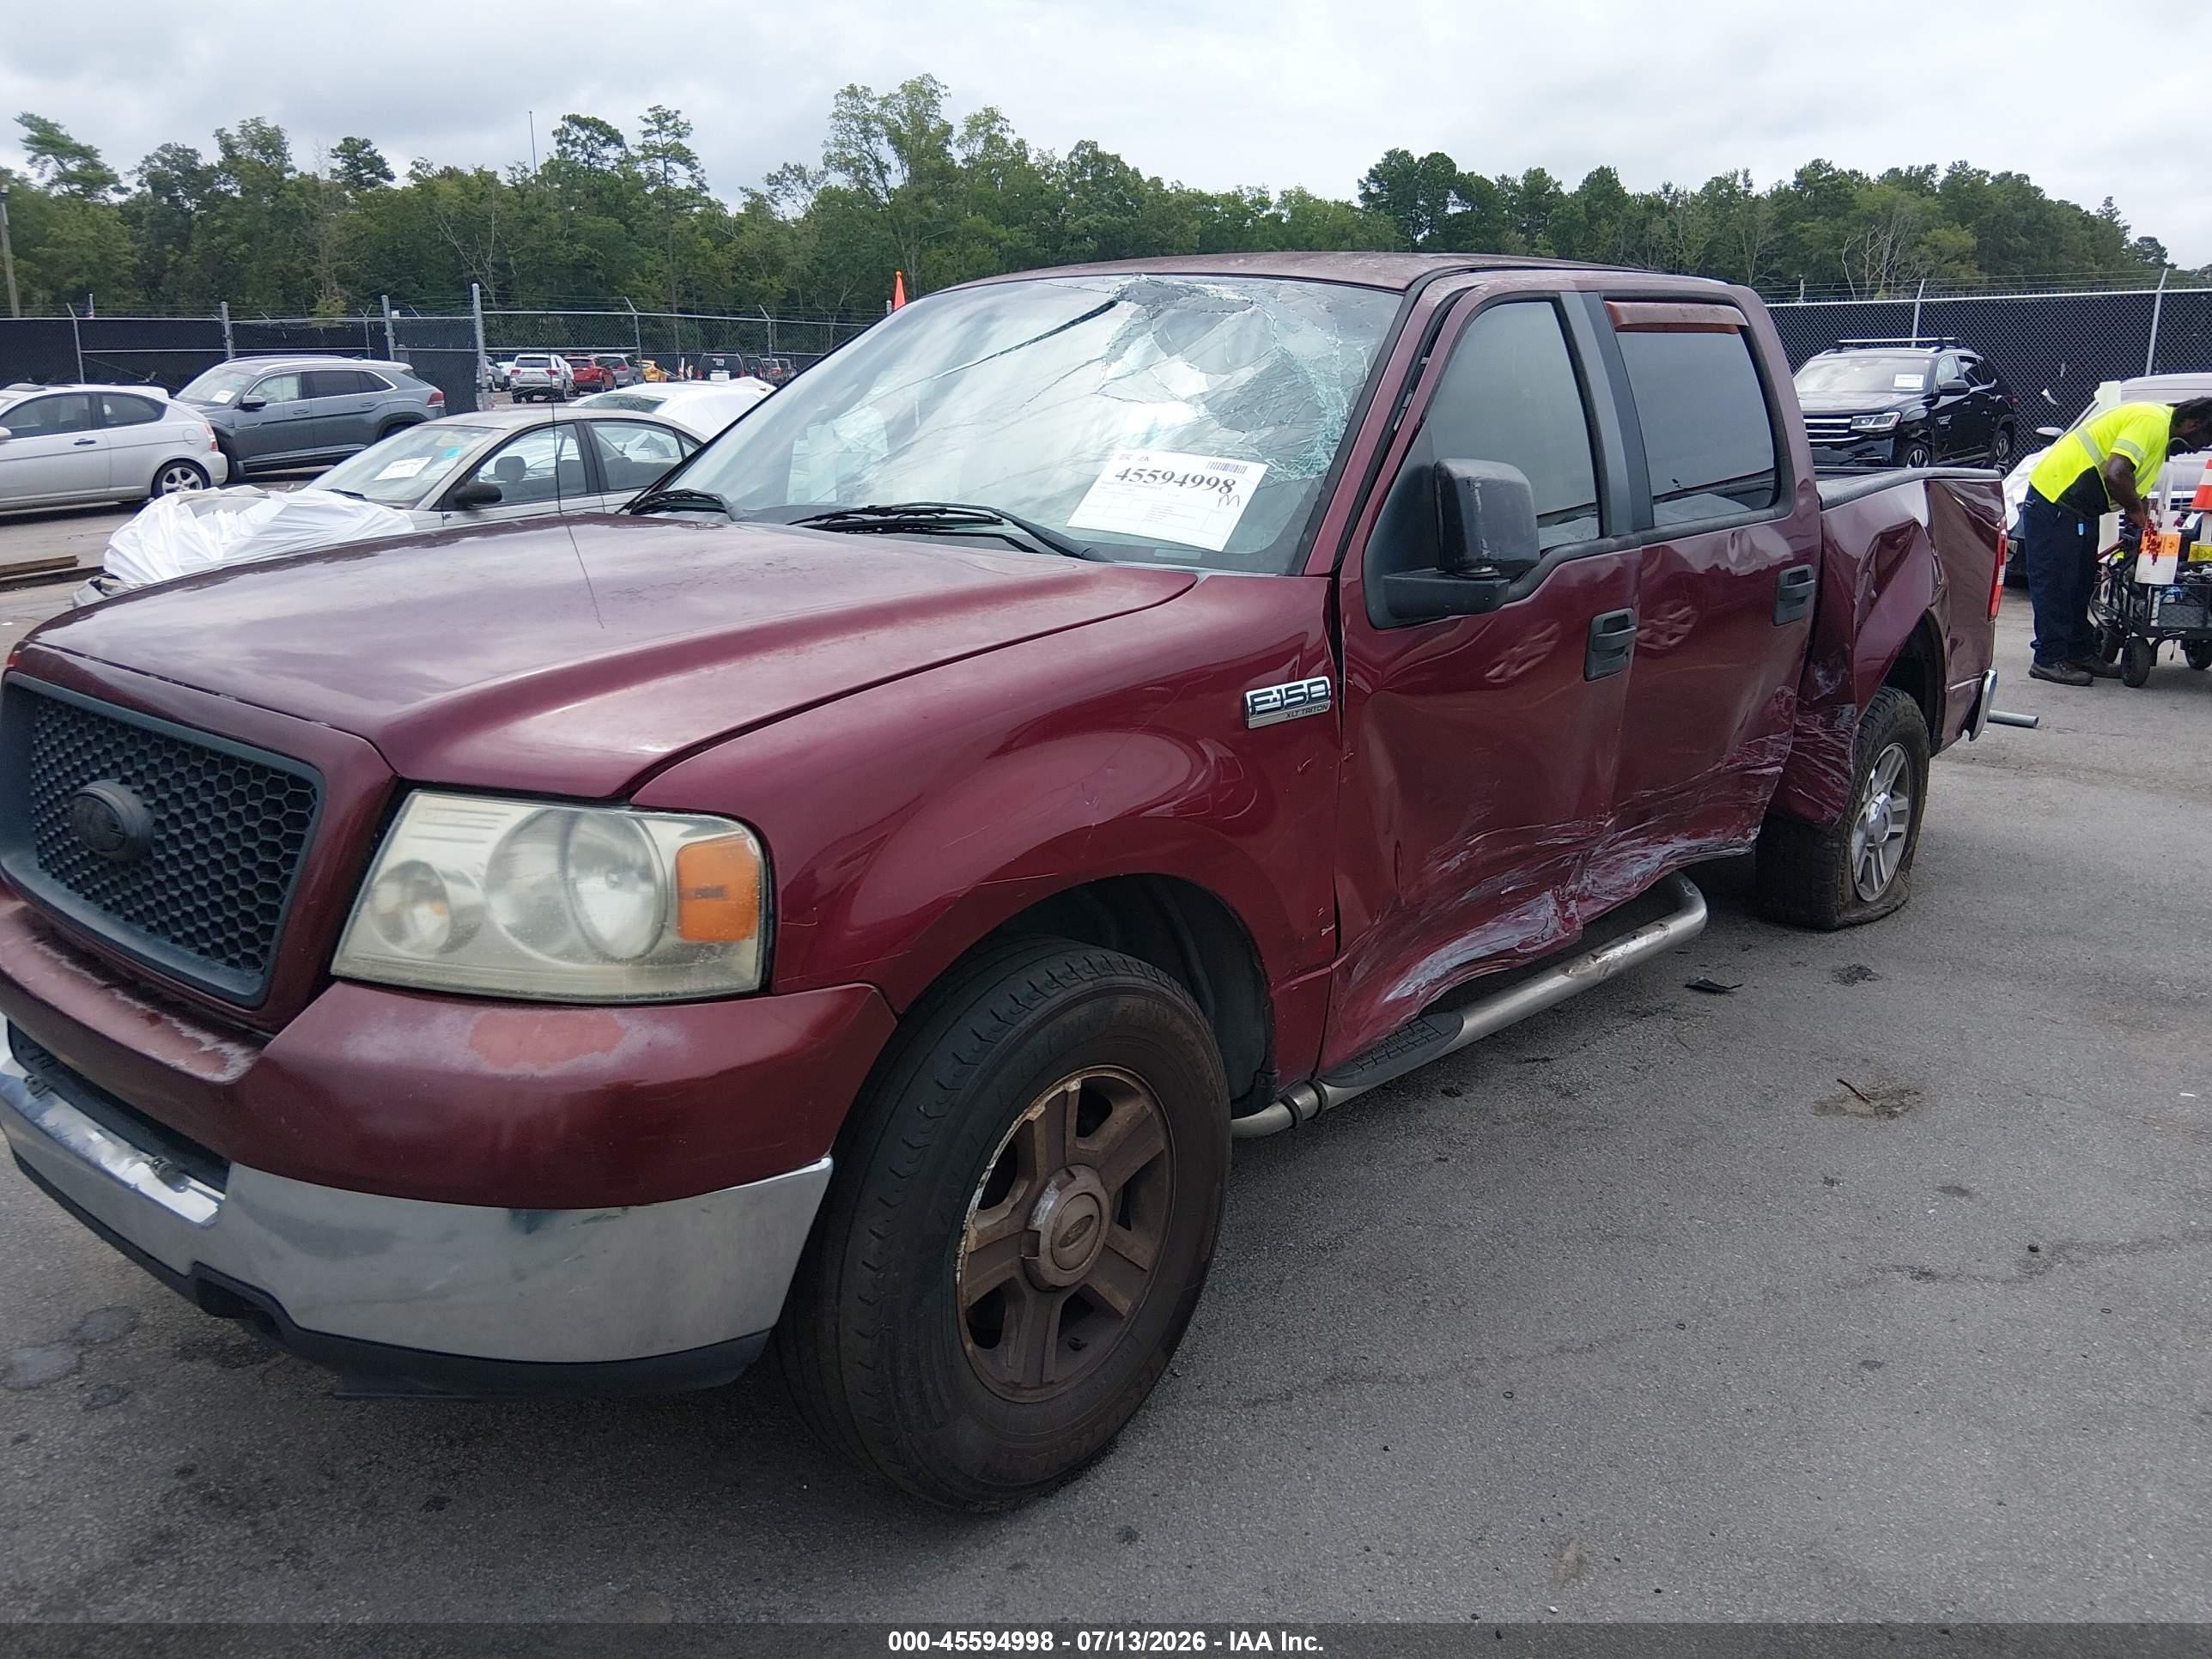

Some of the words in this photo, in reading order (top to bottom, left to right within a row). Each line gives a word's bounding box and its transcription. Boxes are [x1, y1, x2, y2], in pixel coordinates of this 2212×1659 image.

[1115, 467, 1237, 494] 45594998
[1249, 679, 1329, 715] F-150
[1285, 710, 1300, 719] XLT
[1301, 704, 1328, 715] TRITON
